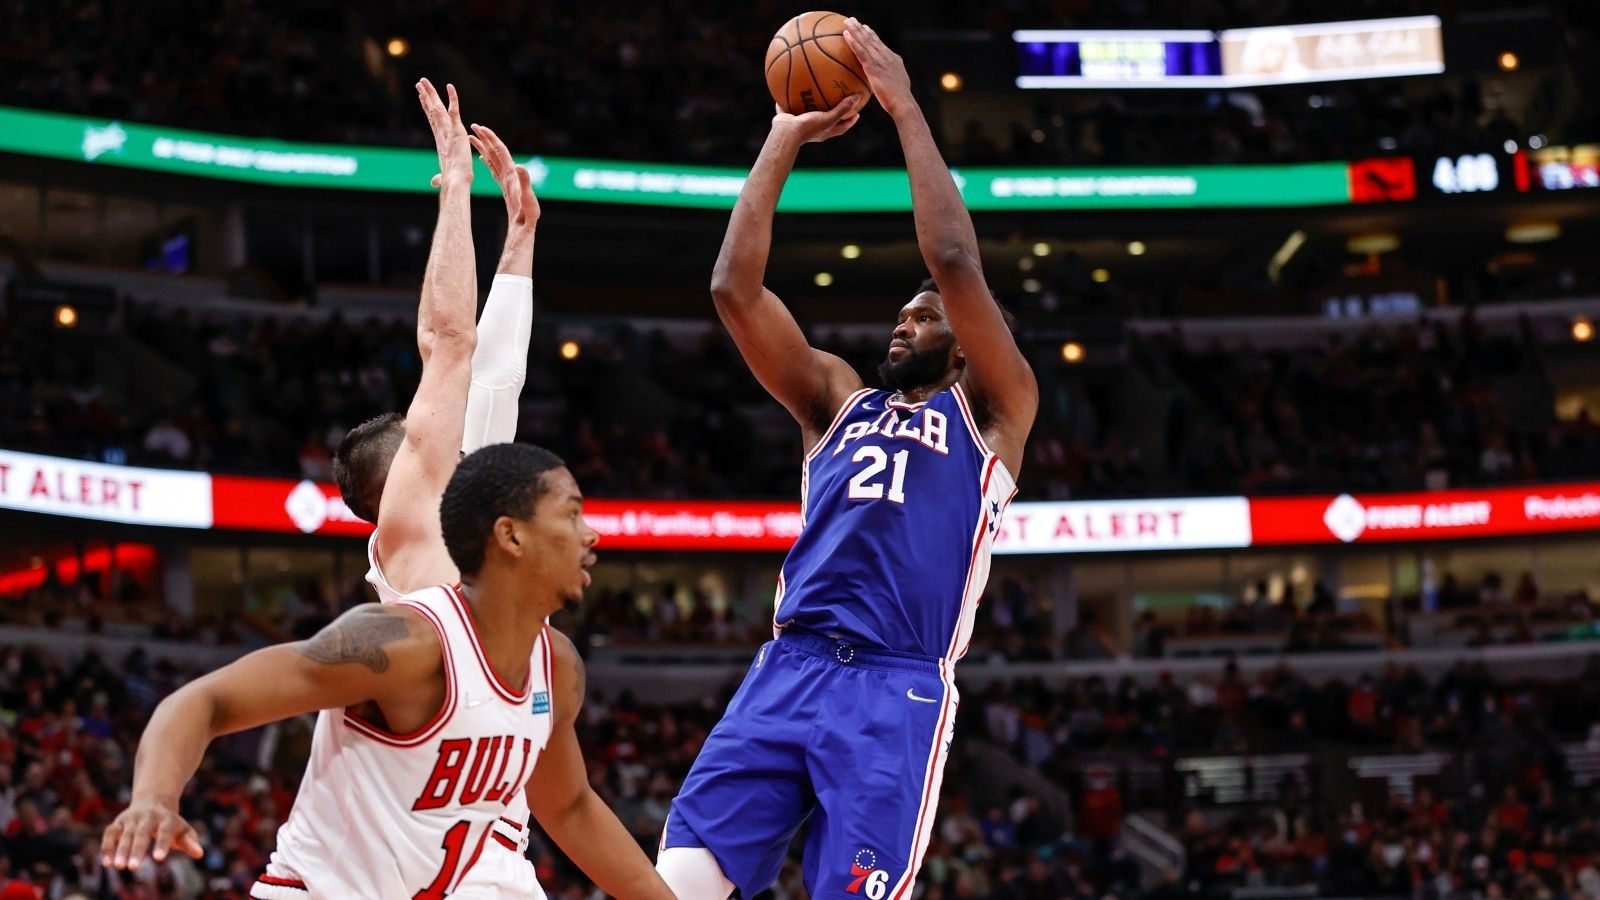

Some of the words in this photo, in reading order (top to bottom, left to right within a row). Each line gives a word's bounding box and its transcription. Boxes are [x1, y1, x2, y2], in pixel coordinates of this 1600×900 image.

[29, 469, 146, 510] ALERT
[848, 445, 910, 504] 21
[1052, 511, 1185, 540] ALERT
[845, 862, 890, 900] 76
